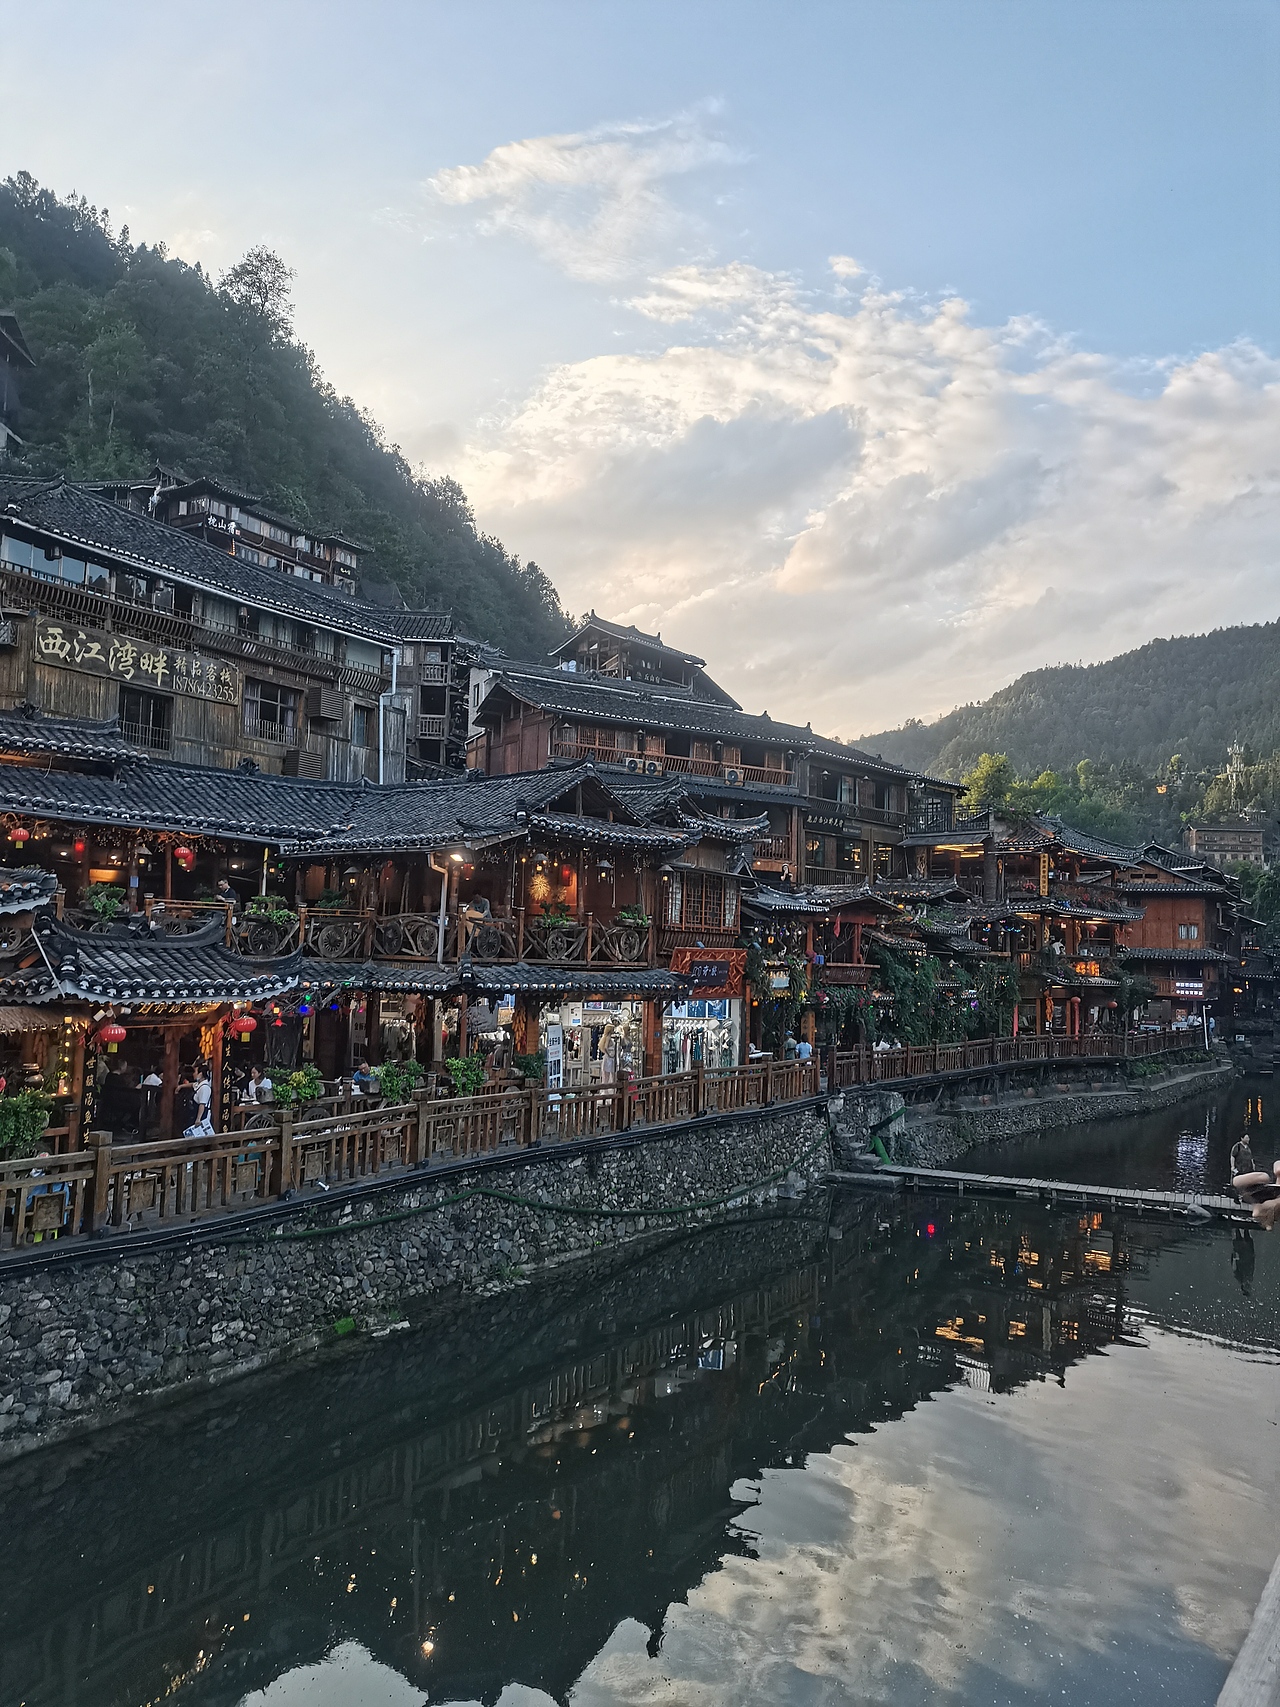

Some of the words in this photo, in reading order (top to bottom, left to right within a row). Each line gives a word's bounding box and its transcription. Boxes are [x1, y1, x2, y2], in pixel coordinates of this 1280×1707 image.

[38, 627, 170, 687] 西江湾畔
[173, 656, 233, 687] 精品客栈
[172, 674, 235, 702] 18786423255
